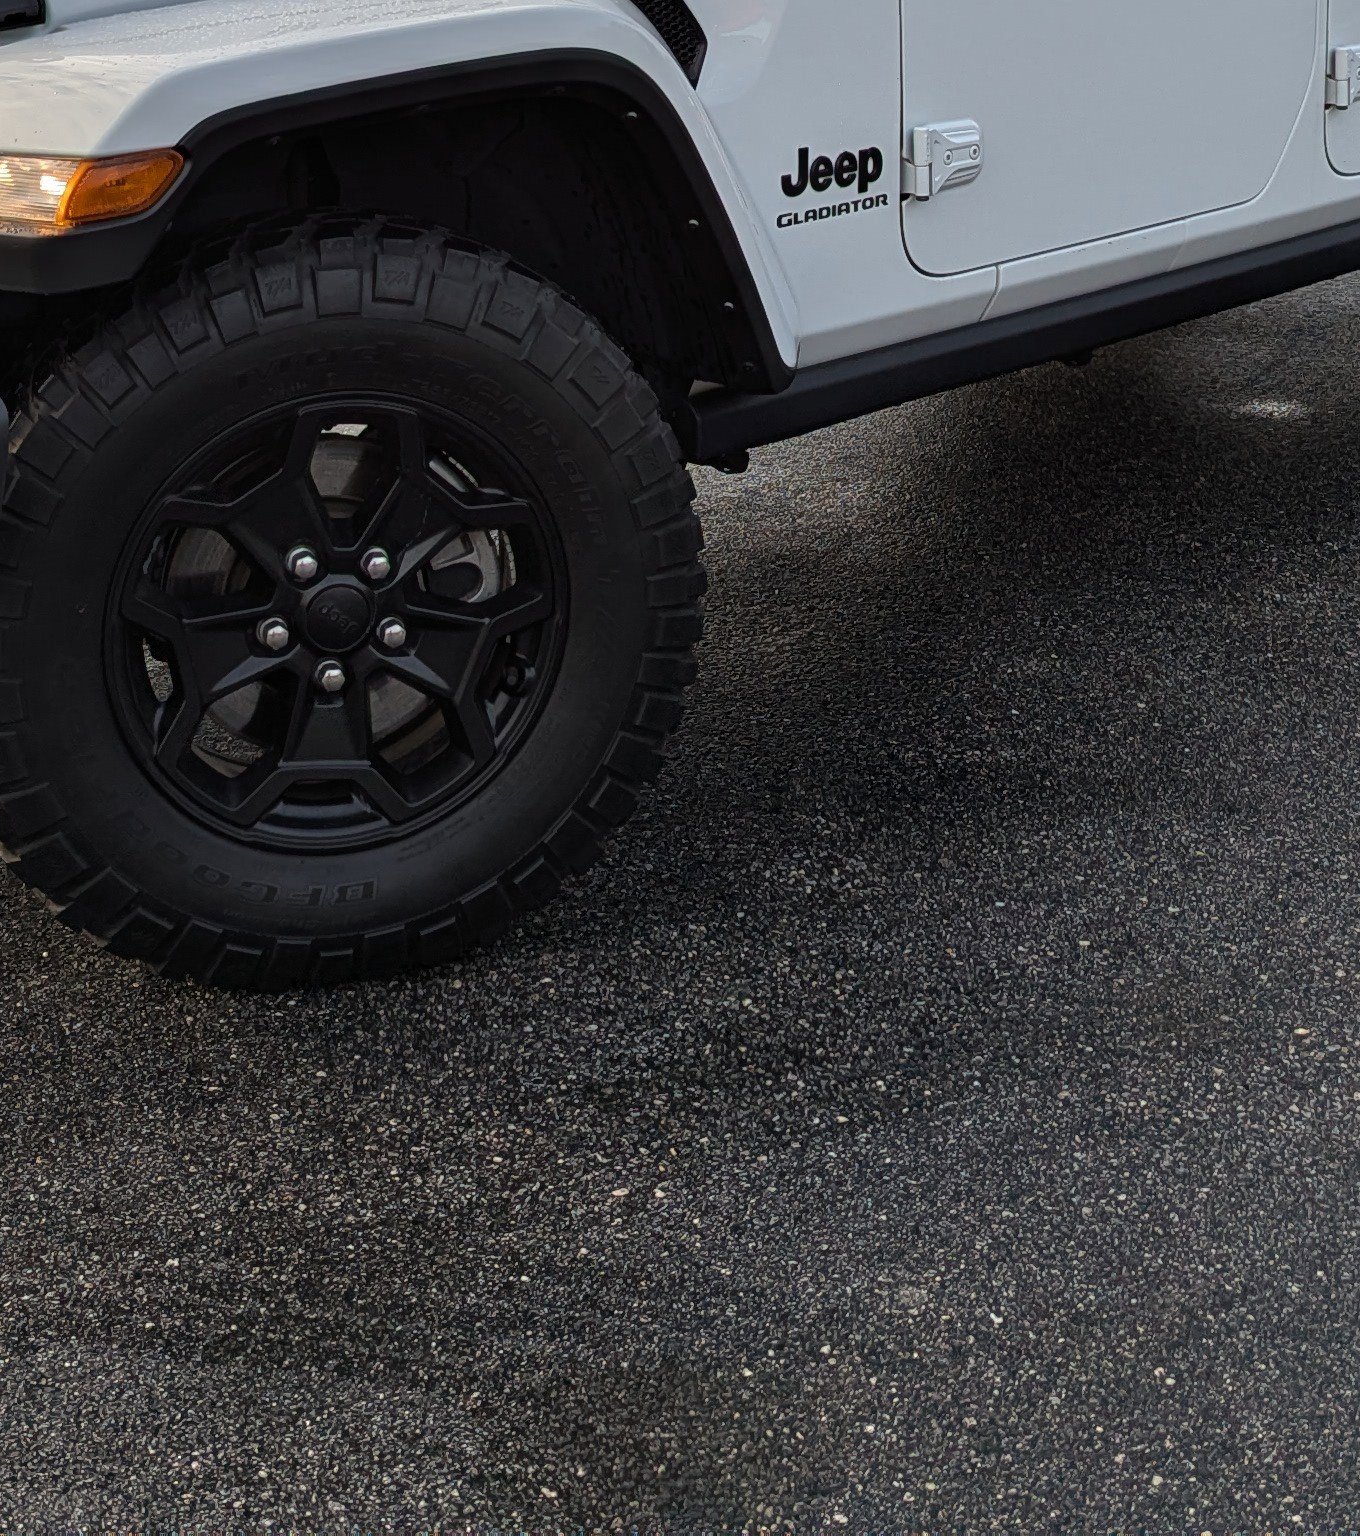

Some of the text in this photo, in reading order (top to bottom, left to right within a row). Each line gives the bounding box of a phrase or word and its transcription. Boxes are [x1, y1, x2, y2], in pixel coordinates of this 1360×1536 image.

[780, 146, 884, 198] Jeep
[776, 193, 889, 229] GLADIATOR
[320, 603, 360, 634] Jeep
